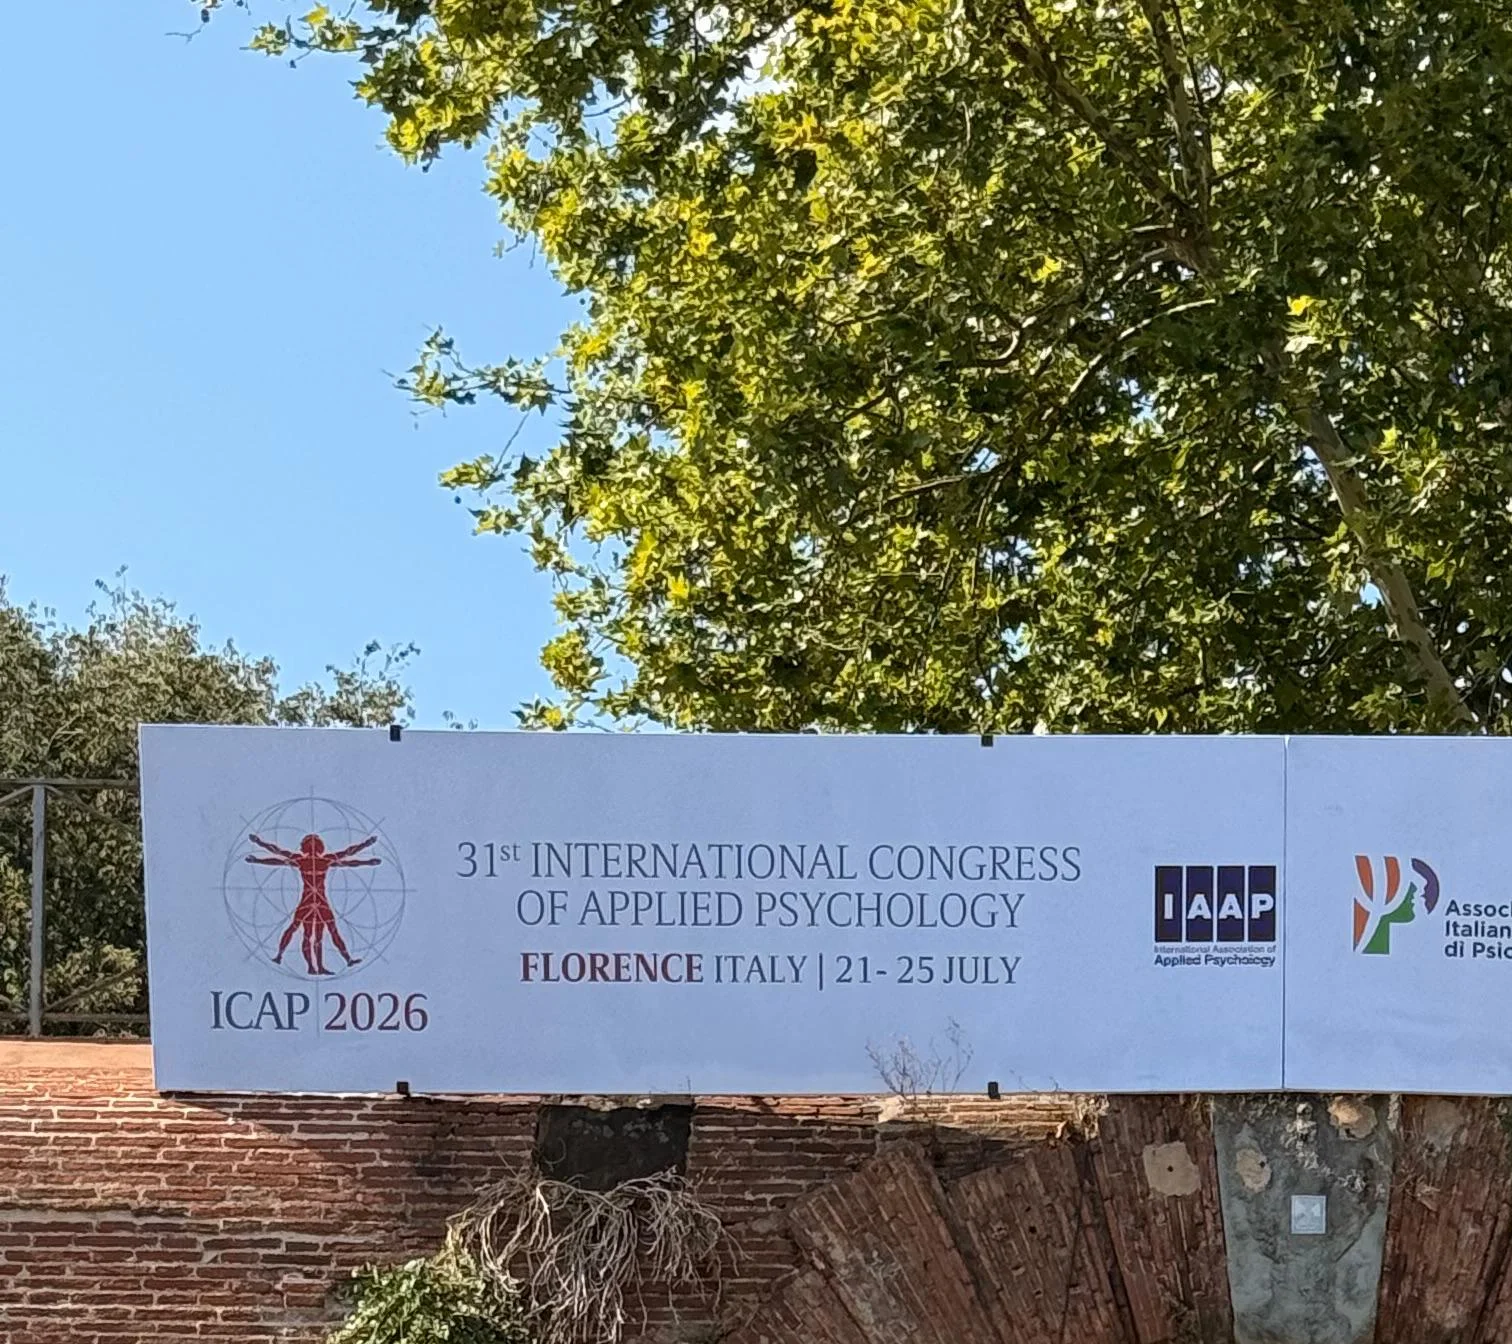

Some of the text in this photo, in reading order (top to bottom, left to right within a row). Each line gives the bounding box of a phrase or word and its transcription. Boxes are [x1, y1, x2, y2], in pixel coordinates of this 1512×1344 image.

[456, 841, 1081, 882] 31st INTERNATIONAL CONGRESS
[516, 889, 1026, 930] OF APPLIED PSYCHOLOGY
[1163, 893, 1275, 920] IAAP
[1154, 954, 1276, 968] Applied Psychology
[1444, 941, 1464, 958] di
[519, 952, 705, 984] FLORENCE
[714, 954, 808, 984] ITALY
[942, 955, 1022, 985] JULY
[209, 990, 429, 1032] ICAP 2026
